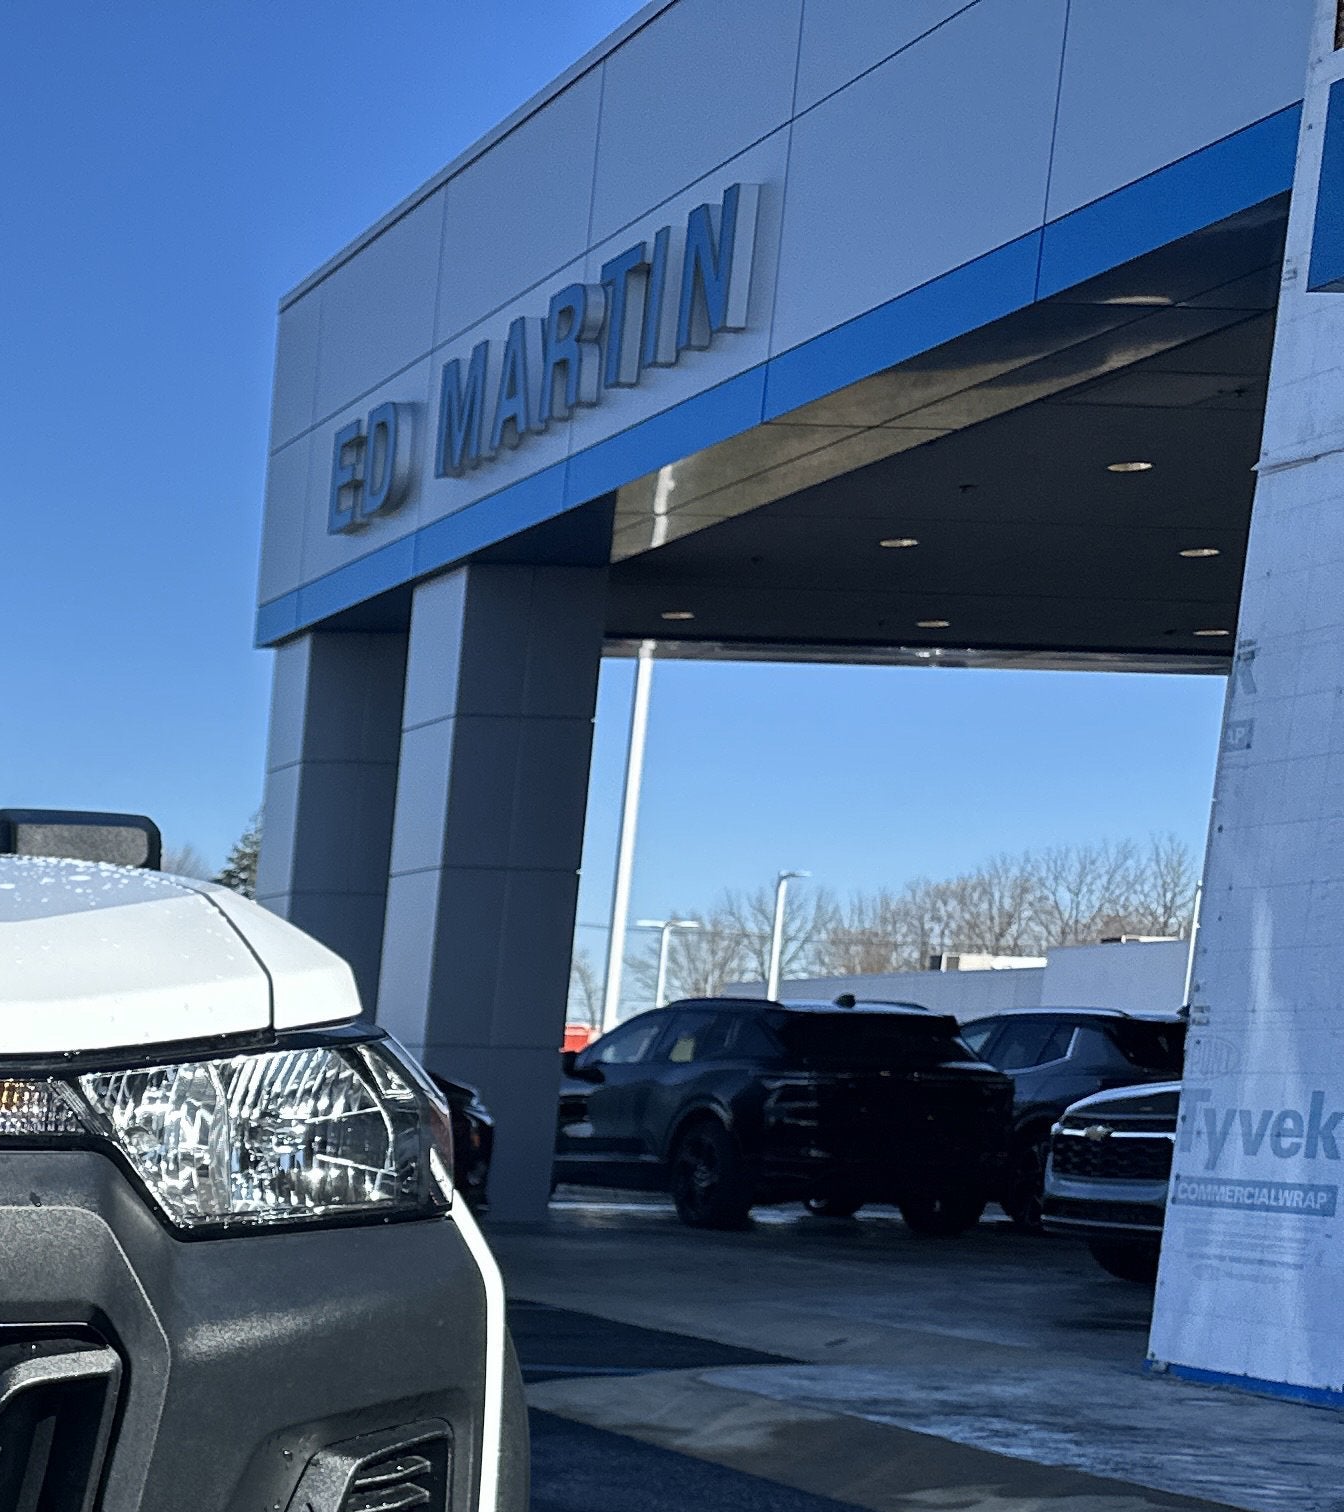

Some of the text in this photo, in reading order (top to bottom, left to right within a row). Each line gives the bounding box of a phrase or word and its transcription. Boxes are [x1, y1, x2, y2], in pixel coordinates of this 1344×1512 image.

[327, 182, 757, 535] ED MARTIN
[1179, 1087, 1344, 1171] Tyvek
